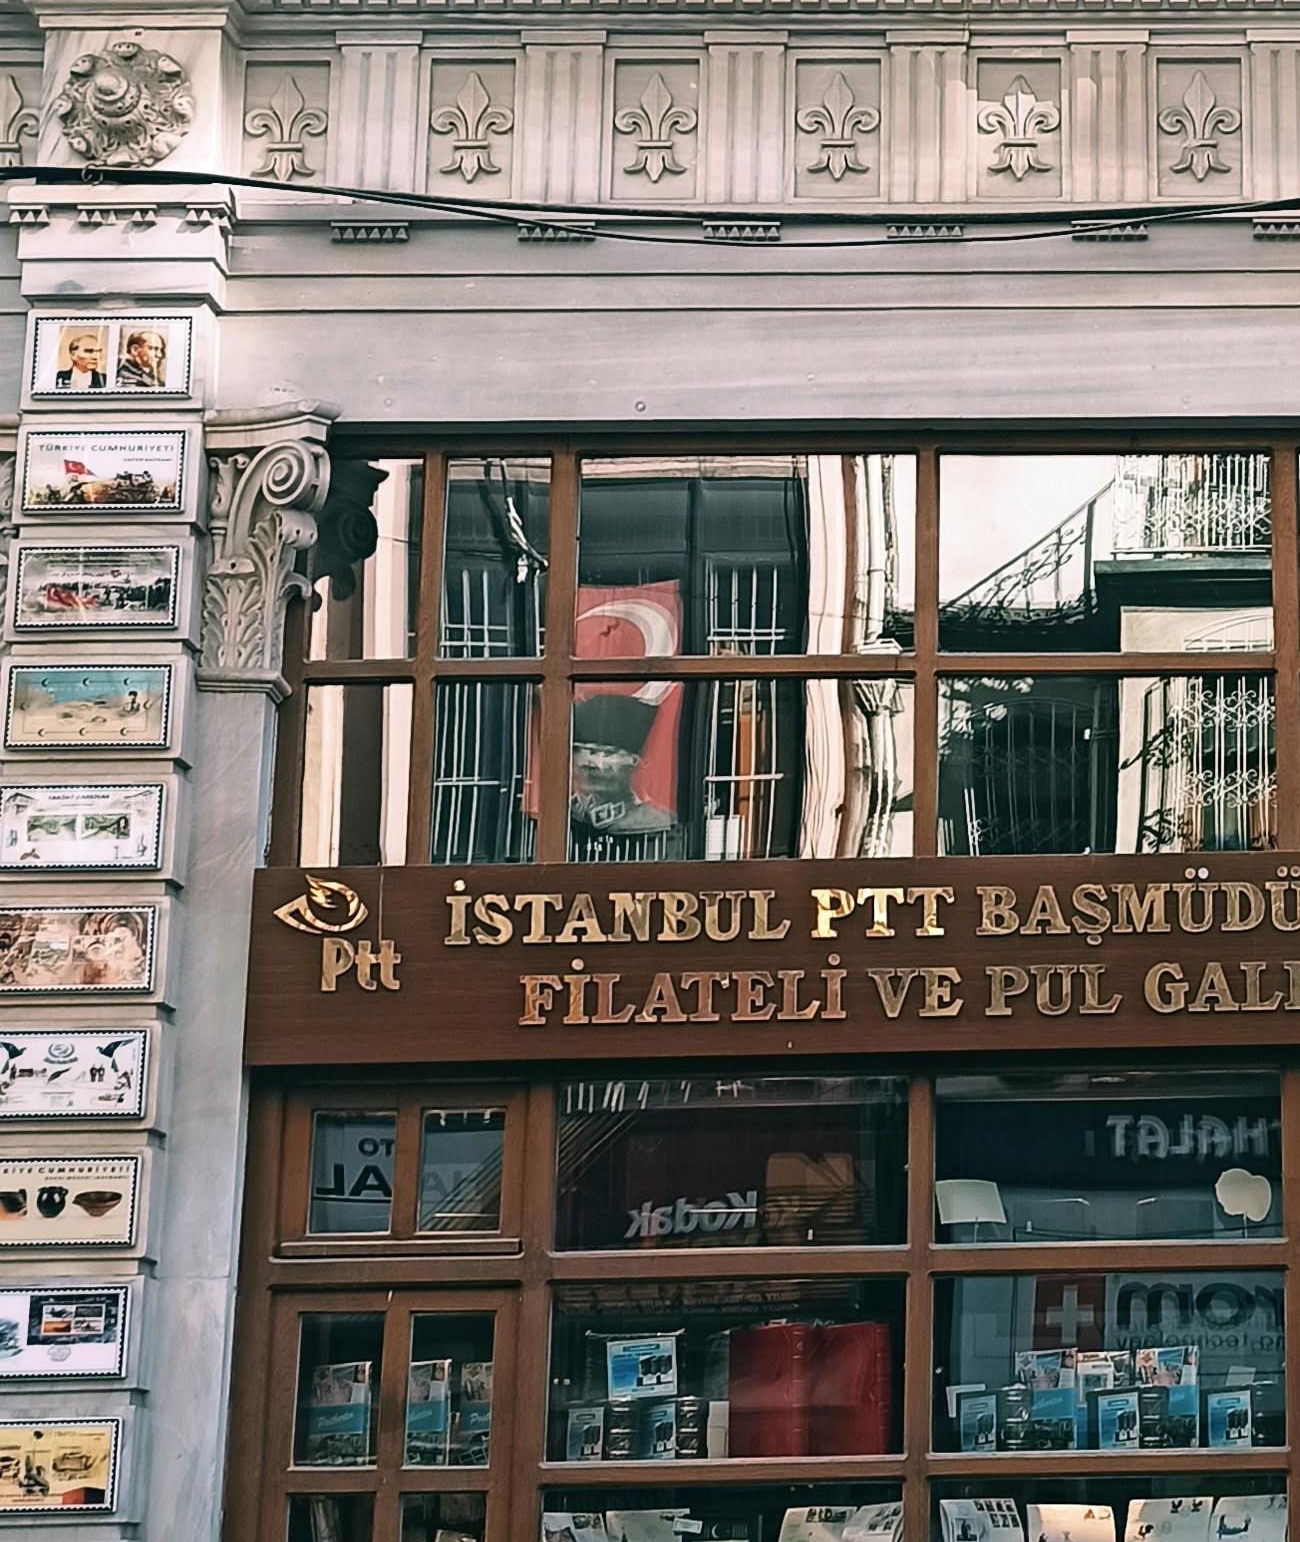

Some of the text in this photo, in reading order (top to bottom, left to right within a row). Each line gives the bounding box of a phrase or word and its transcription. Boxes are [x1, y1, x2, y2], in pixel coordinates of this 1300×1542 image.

[445, 880, 791, 945] İSTANBUL
[810, 884, 955, 938] PTT
[320, 938, 402, 992] Ptt
[518, 953, 847, 1026] FİLATELİ
[866, 965, 962, 1018] VE
[985, 963, 1123, 1016] PUL
